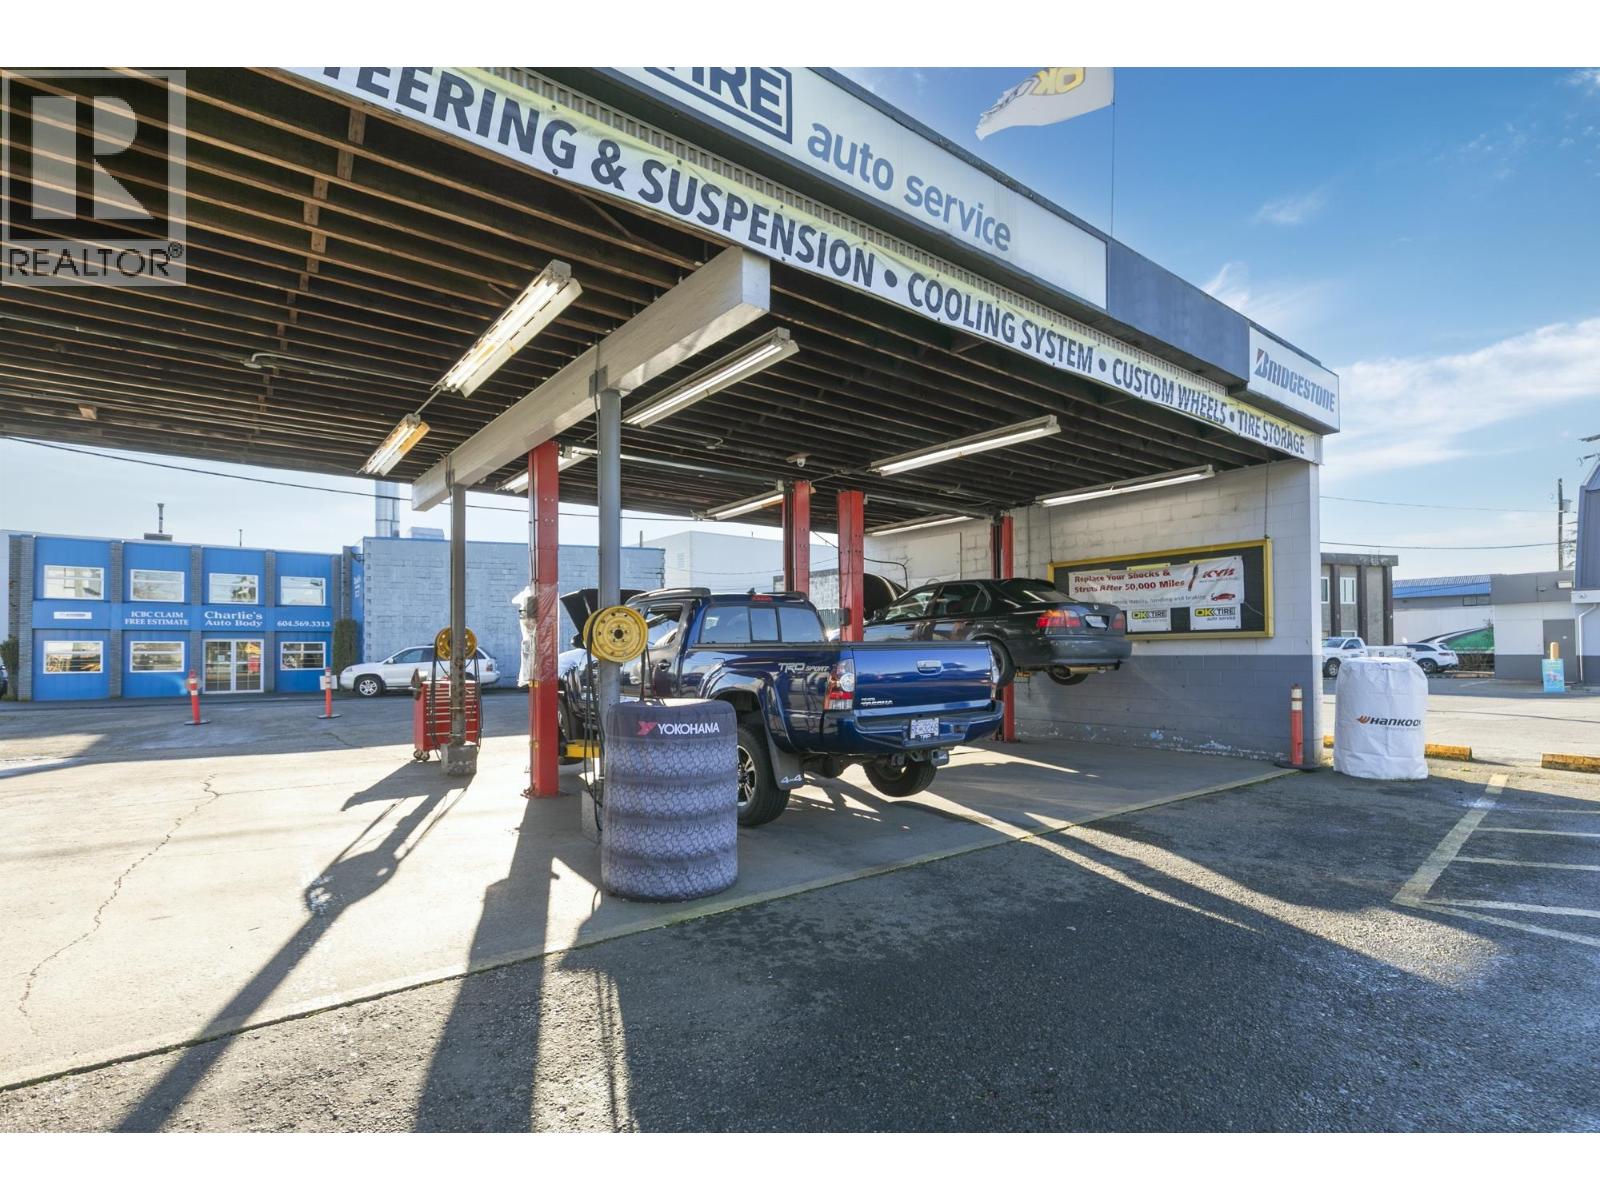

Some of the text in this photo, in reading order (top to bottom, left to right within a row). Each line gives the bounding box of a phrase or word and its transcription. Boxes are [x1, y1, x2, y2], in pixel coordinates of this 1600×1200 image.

[807, 120, 1012, 252] auto service
[323, 67, 1305, 455] EERING & SUSPENSION COOLING SYSTEM CUSTOM WHEELS TIRE STORAGE
[1254, 348, 1335, 412] BRIDGESTONE
[1074, 575, 1105, 583] Replace
[1107, 573, 1125, 581] Your
[1128, 571, 1160, 579] Shocks
[1100, 583, 1123, 592] After
[1125, 582, 1156, 592] 50,000
[1159, 579, 1185, 588] Miles
[204, 610, 263, 620] Charlie's
[1195, 607, 1236, 617] OK TIRE
[148, 618, 189, 626] ESTIMATE
[205, 619, 263, 628] Auto Body
[805, 665, 830, 673] SPORT
[657, 722, 720, 735] YOKOHAMA
